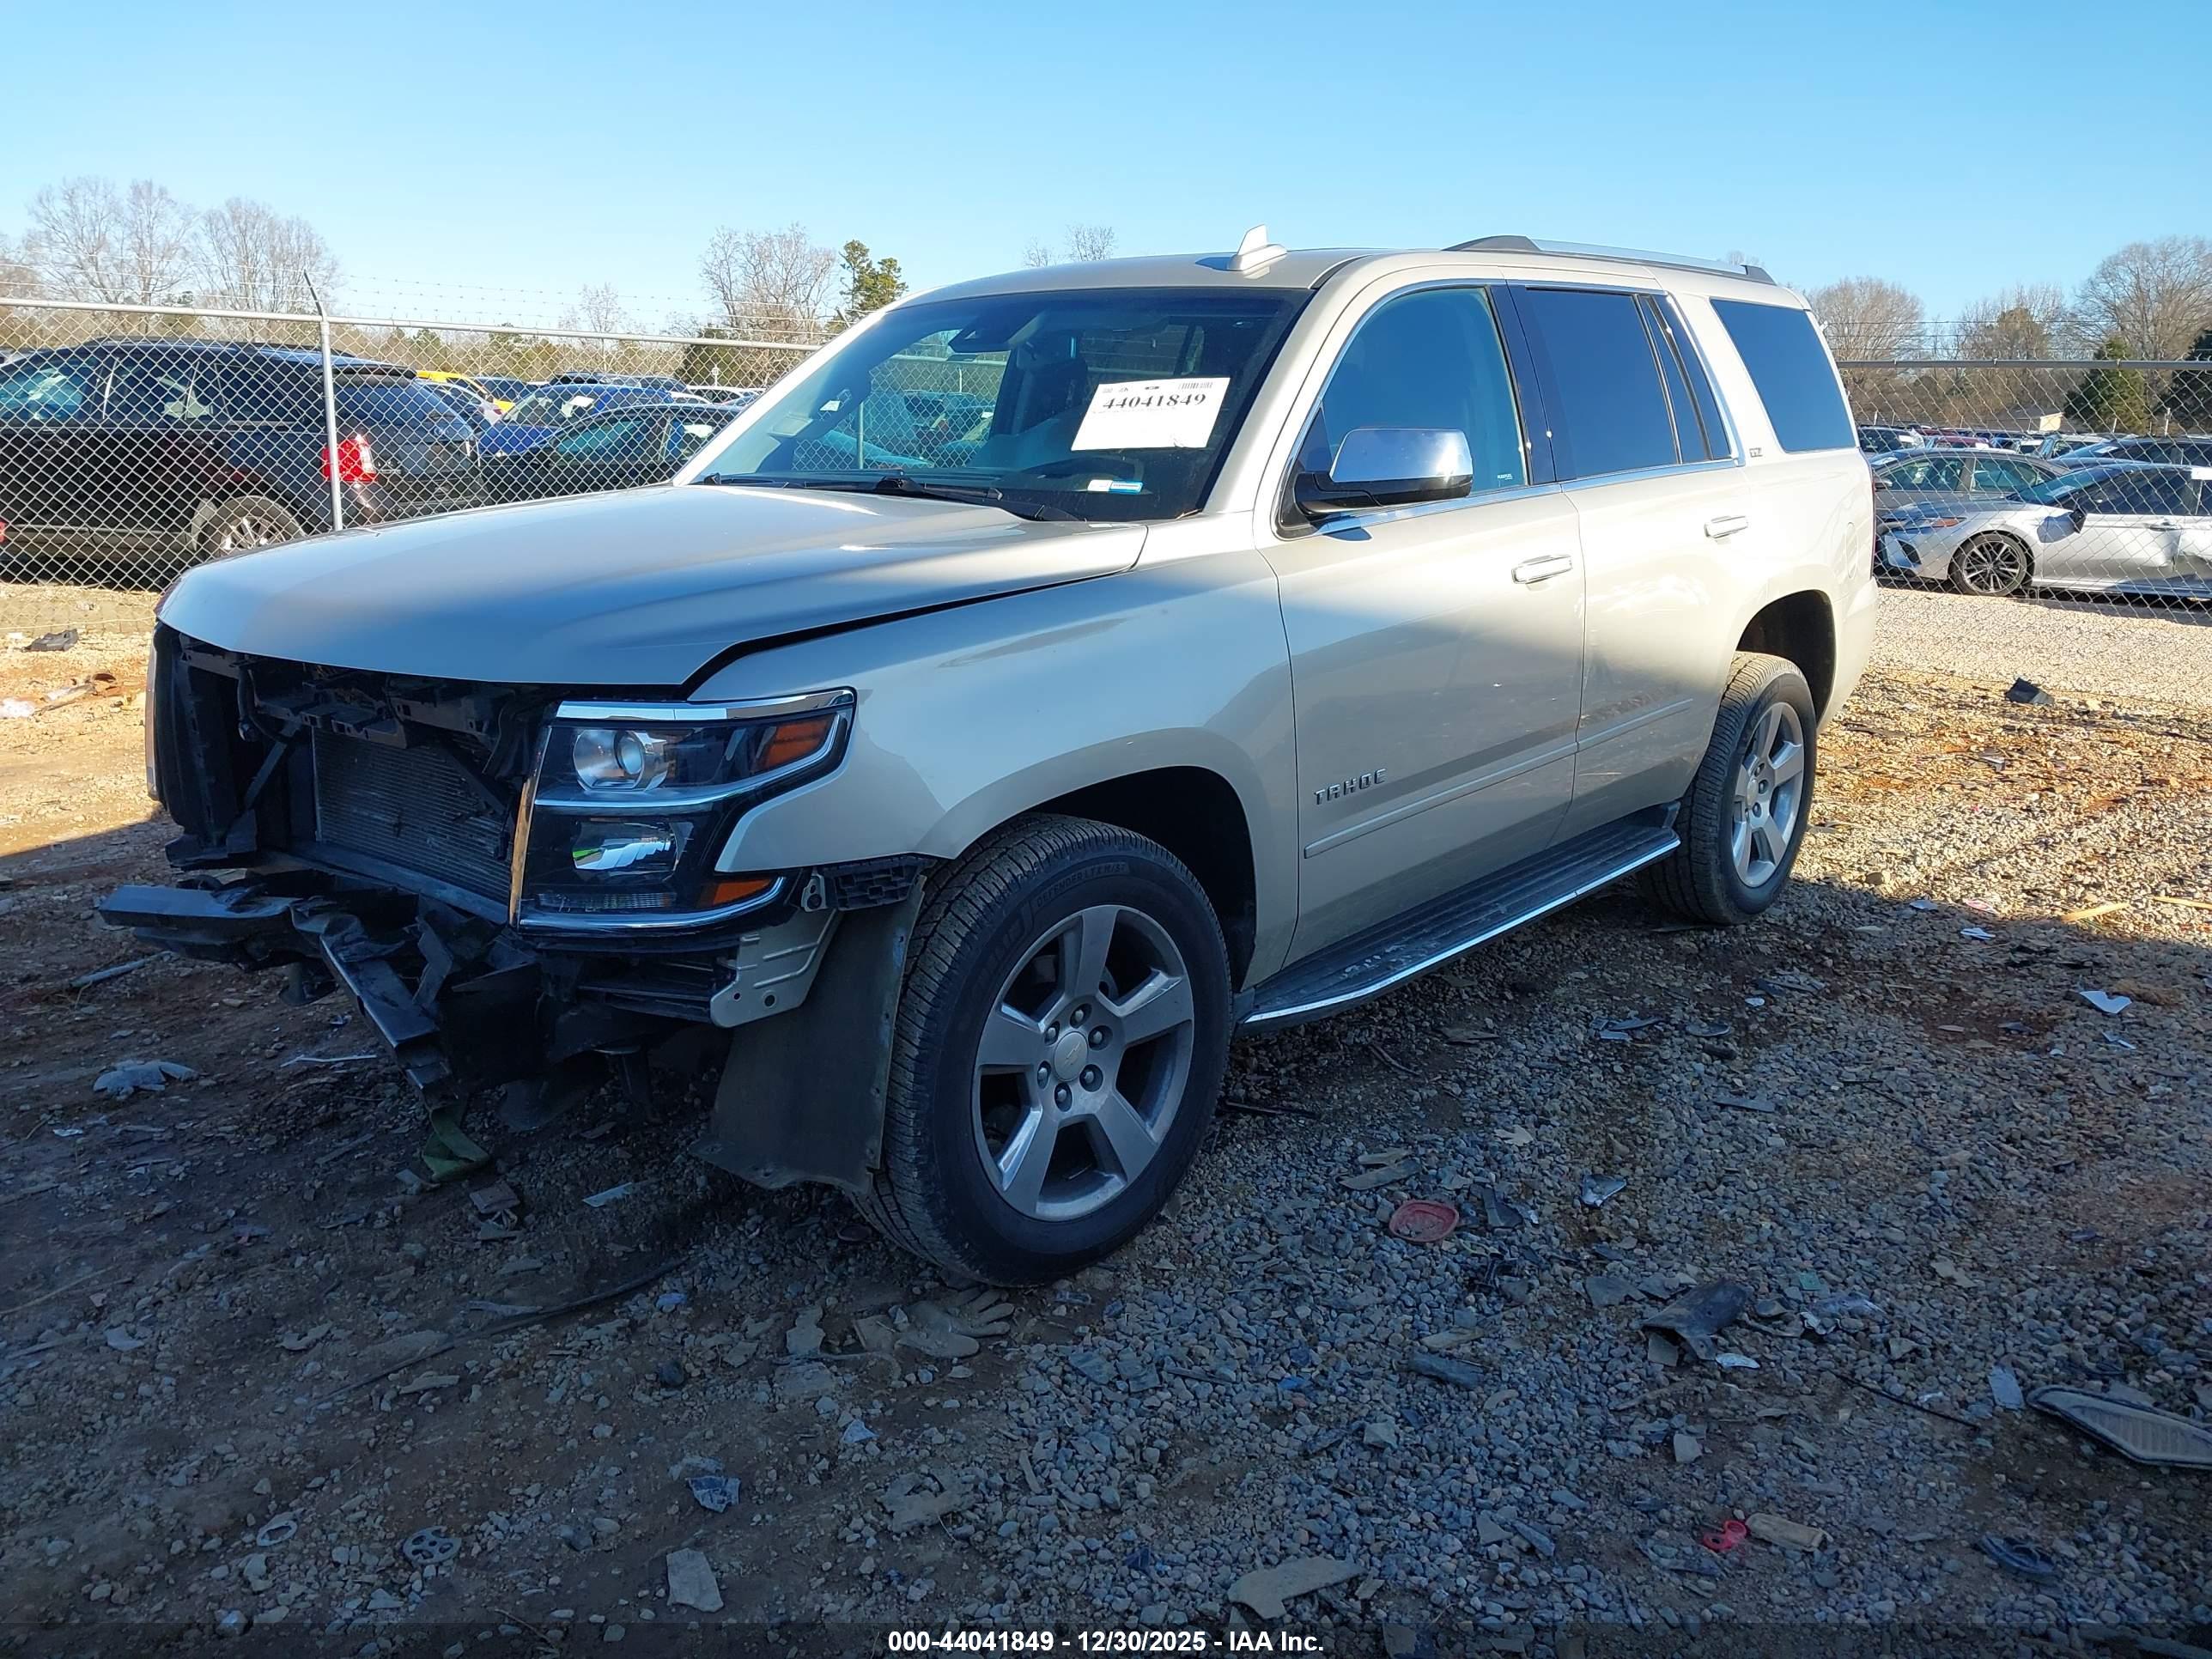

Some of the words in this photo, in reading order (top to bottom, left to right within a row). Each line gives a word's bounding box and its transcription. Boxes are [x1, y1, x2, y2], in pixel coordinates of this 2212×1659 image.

[1102, 393, 1206, 409] 44041849
[1313, 768, 1387, 805] TAHOE
[1036, 871, 1084, 908] DEFENDER
